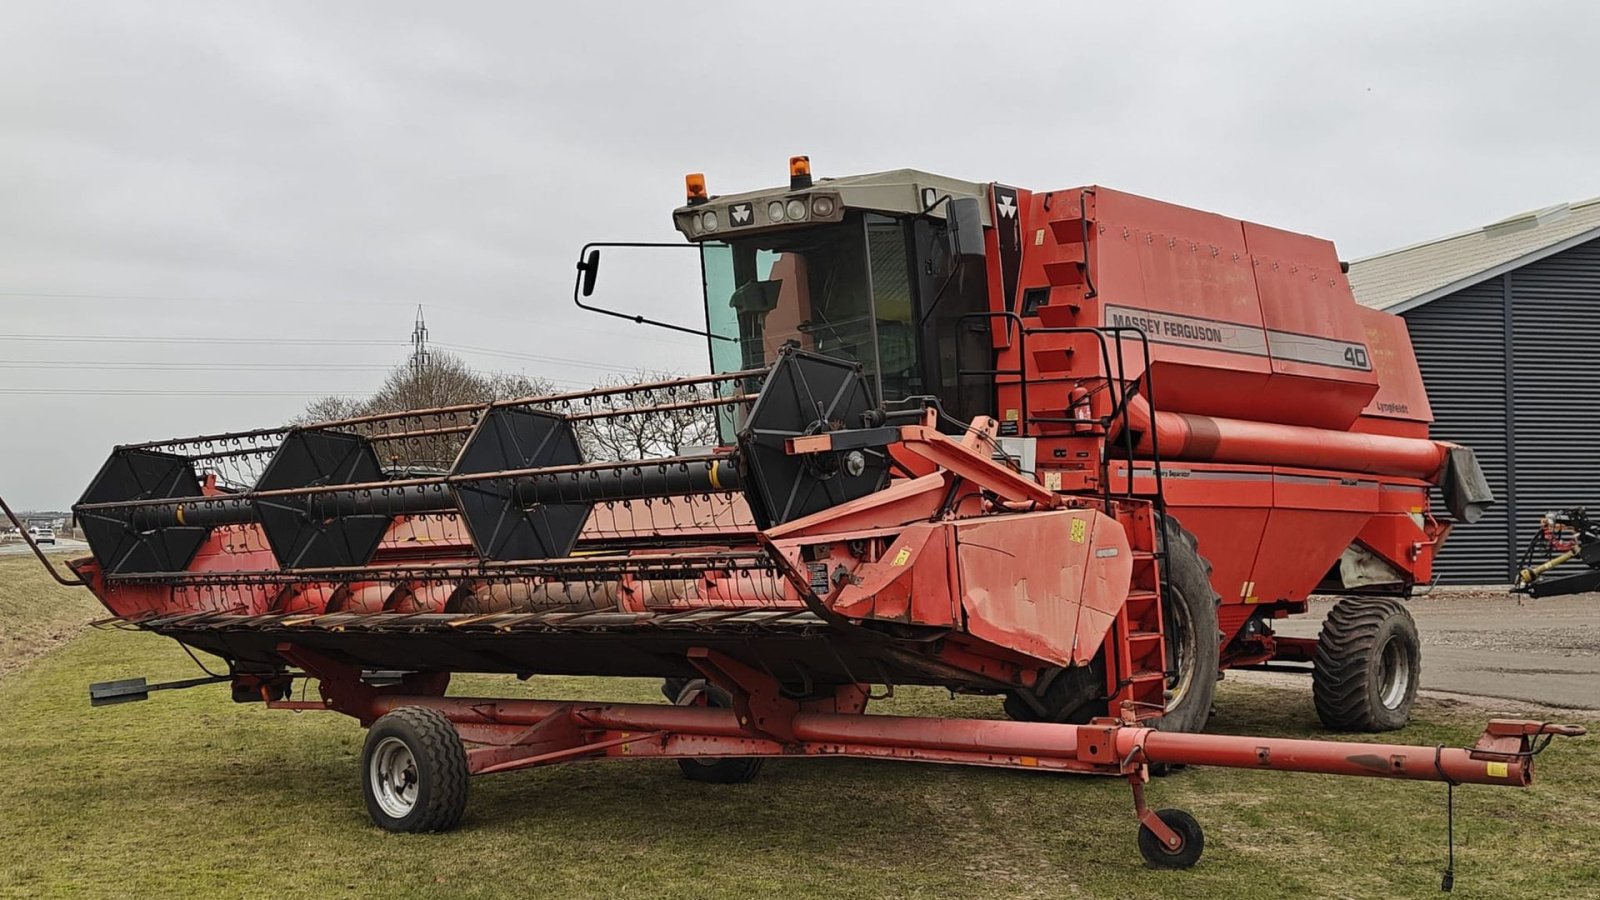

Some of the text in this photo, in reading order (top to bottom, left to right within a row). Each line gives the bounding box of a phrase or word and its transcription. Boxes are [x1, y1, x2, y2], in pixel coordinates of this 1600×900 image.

[1113, 314, 1222, 342] MASSEY FERGUSON
[1344, 347, 1367, 367] 40
